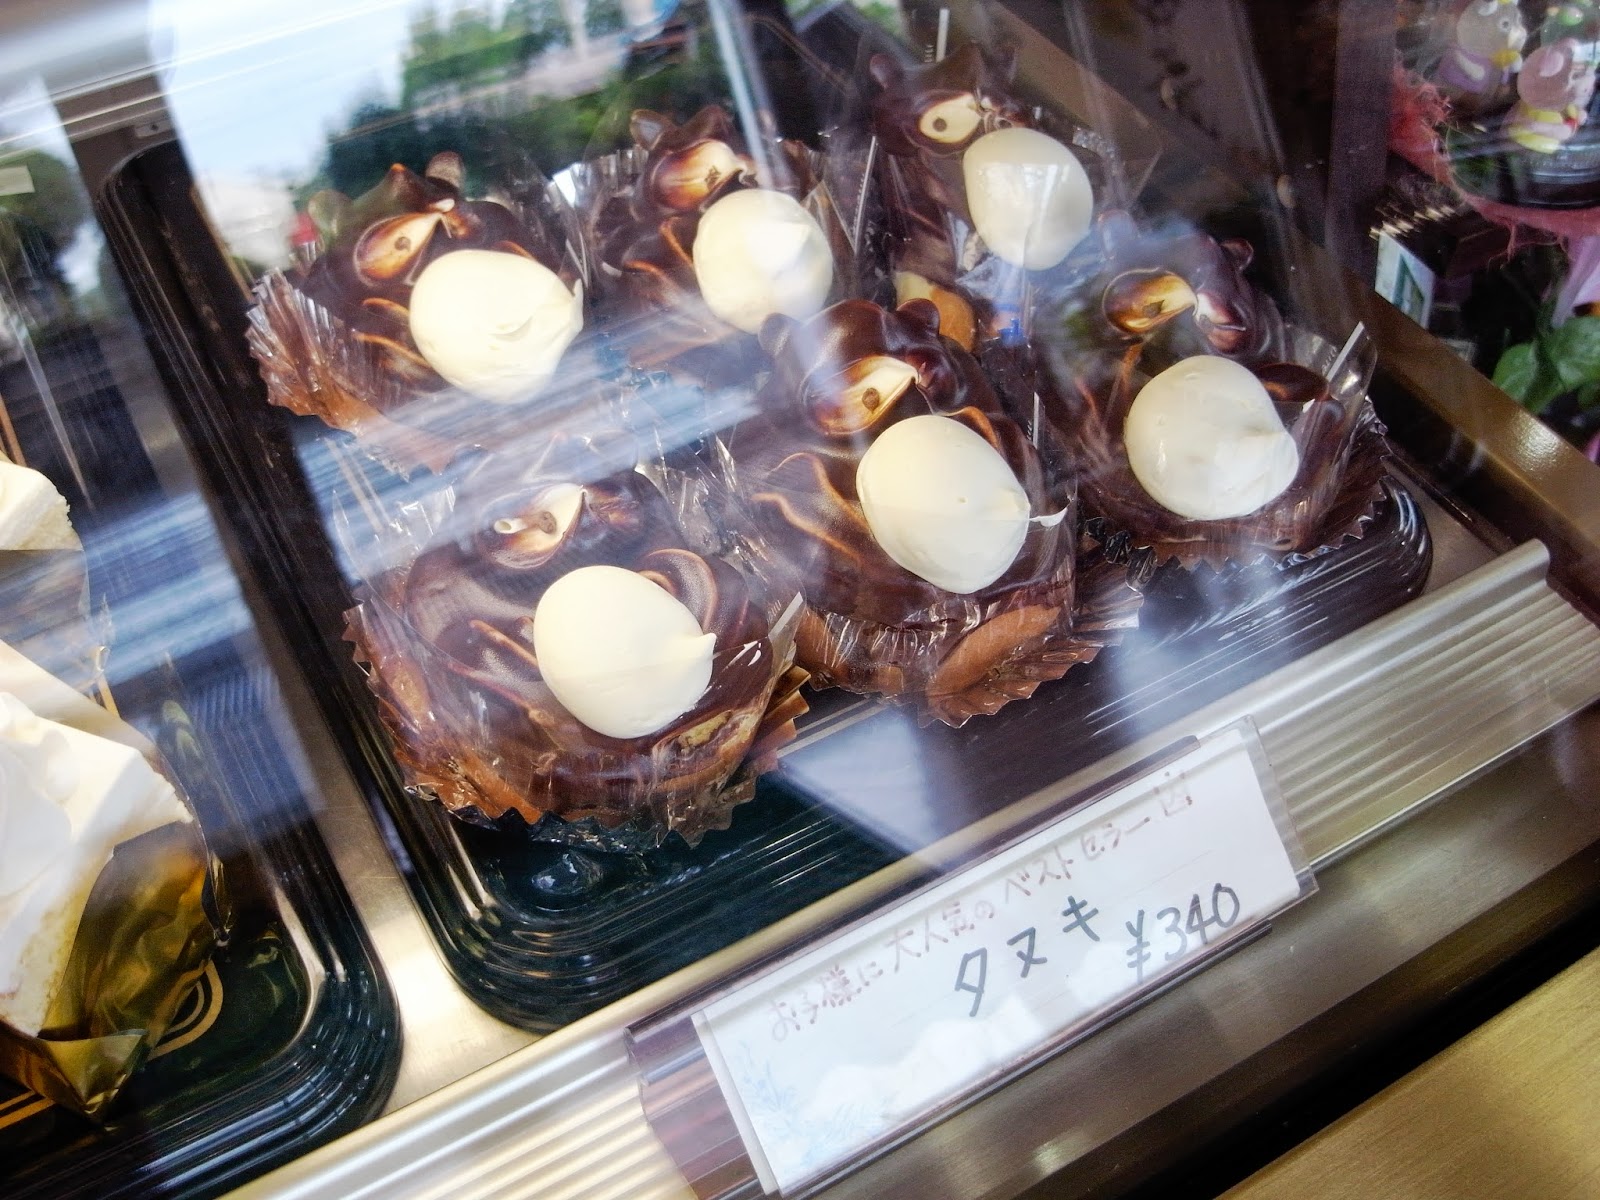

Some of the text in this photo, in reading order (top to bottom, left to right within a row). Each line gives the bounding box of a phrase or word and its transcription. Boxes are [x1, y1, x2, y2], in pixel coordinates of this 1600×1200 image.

[954, 895, 1101, 1017] タヌキ
[1125, 882, 1240, 985] ¥340
